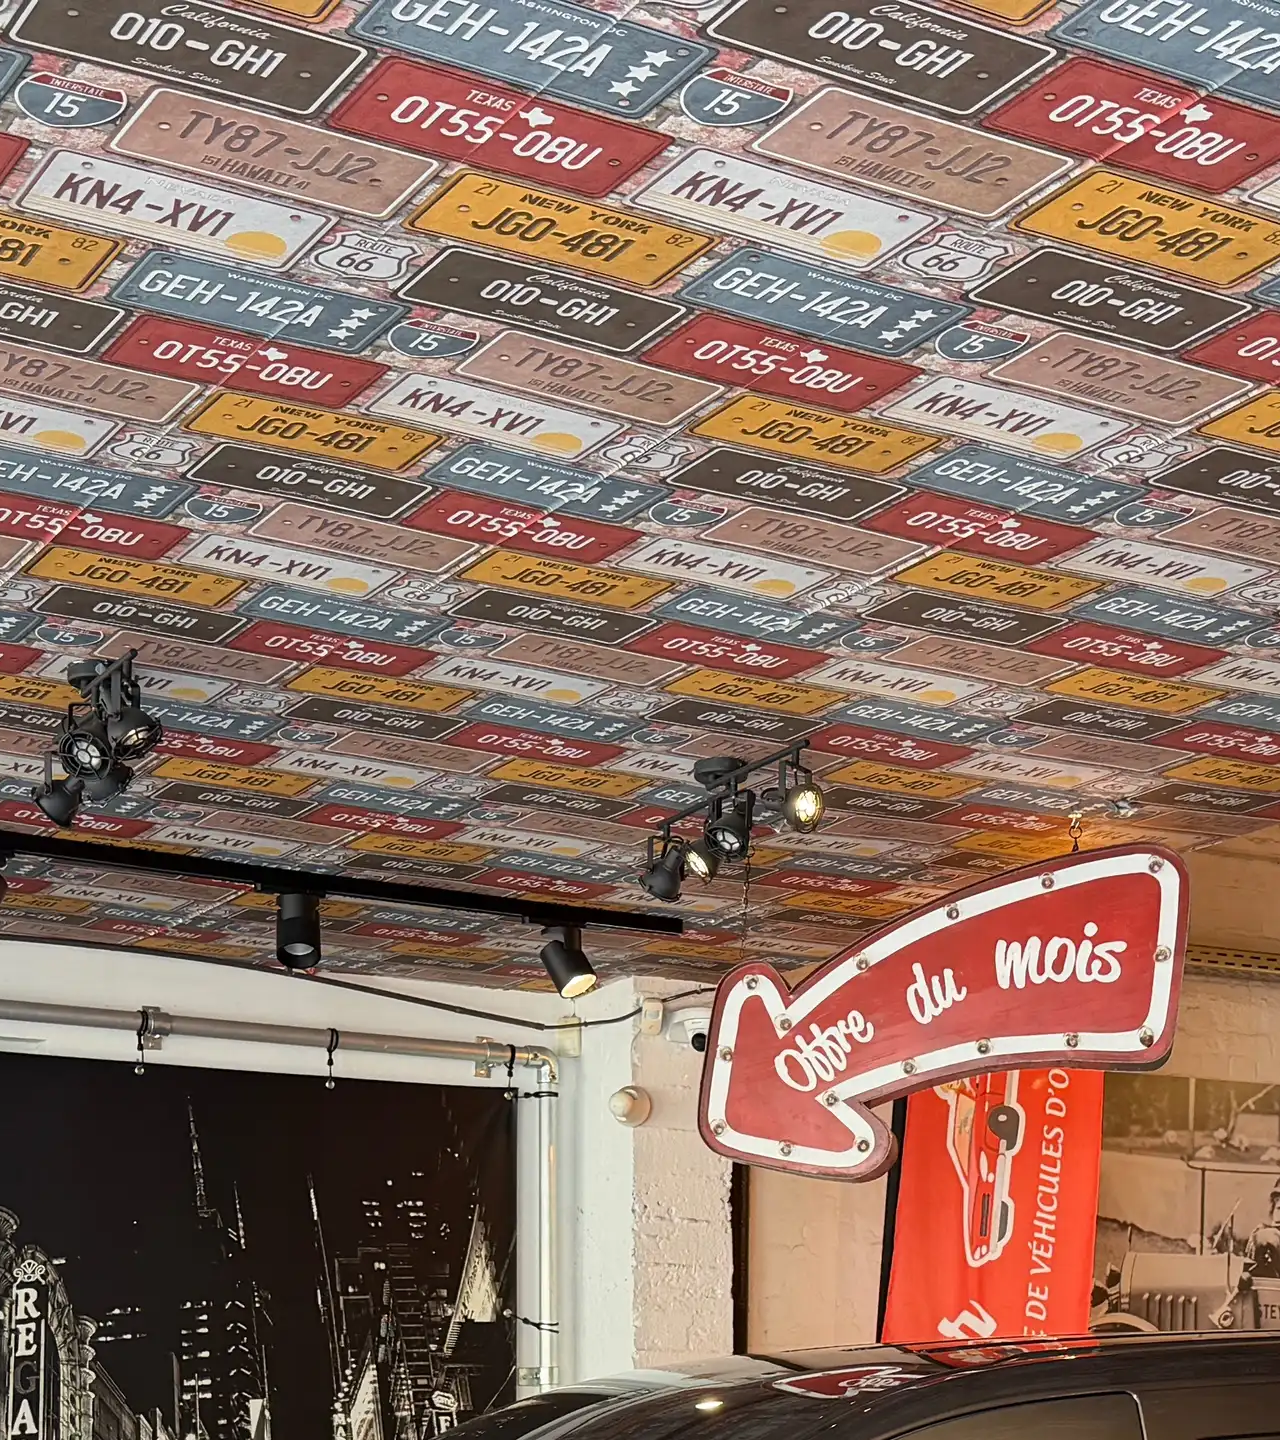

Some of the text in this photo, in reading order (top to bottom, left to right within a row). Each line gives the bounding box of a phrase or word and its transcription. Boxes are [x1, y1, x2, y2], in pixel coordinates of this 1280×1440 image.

[41, 89, 87, 118] 15
[700, 83, 753, 112] 15
[1129, 86, 1185, 109] TEXAS
[517, 192, 655, 235] NEW YORK
[335, 250, 380, 272] 66
[922, 251, 970, 272] 66
[906, 962, 967, 1024] du
[995, 922, 1127, 990] mois
[1027, 1125, 1065, 1276] VÉHICULES
[1025, 1282, 1049, 1321] DE
